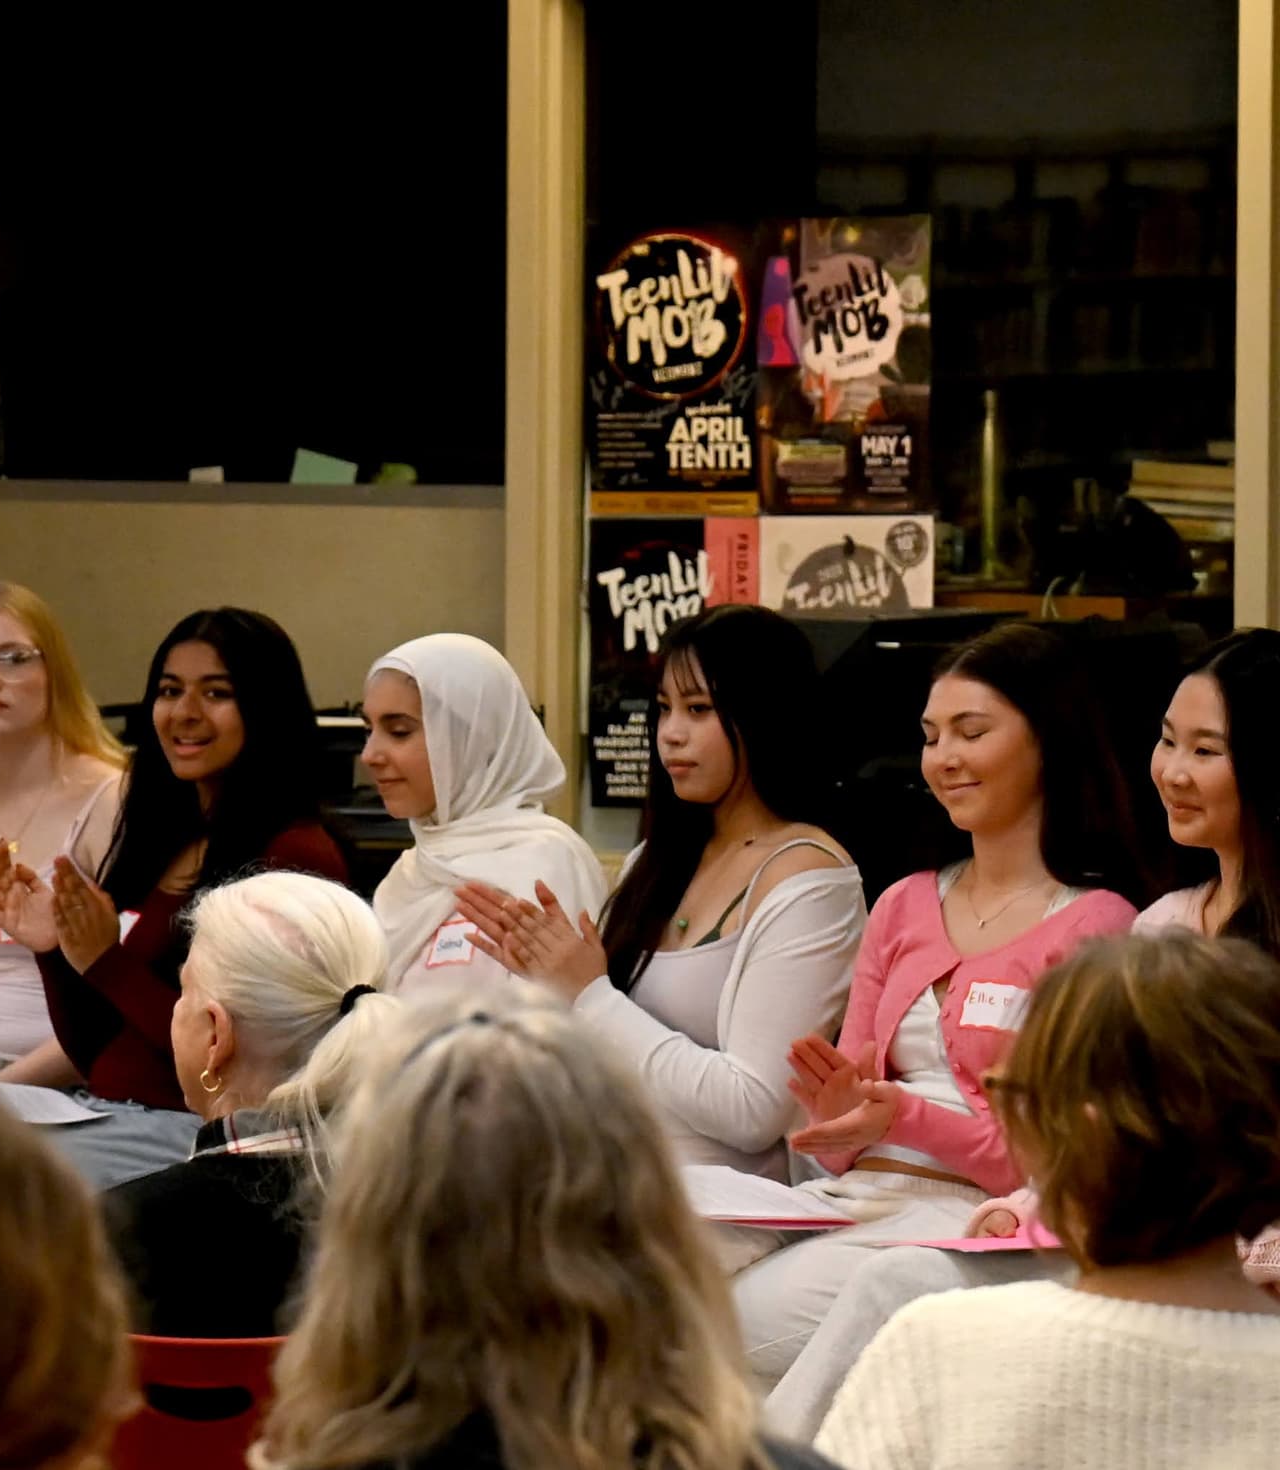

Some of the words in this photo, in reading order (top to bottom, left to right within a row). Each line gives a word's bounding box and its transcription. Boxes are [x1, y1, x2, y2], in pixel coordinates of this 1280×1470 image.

[627, 297, 726, 366] MOB
[813, 299, 889, 354] MOB
[669, 417, 750, 442] APRIL
[665, 442, 752, 469] TENTH
[861, 436, 899, 456] MAY
[901, 435, 912, 456] 1
[736, 533, 749, 596] FRIDAY
[968, 990, 995, 1006] Ellie
